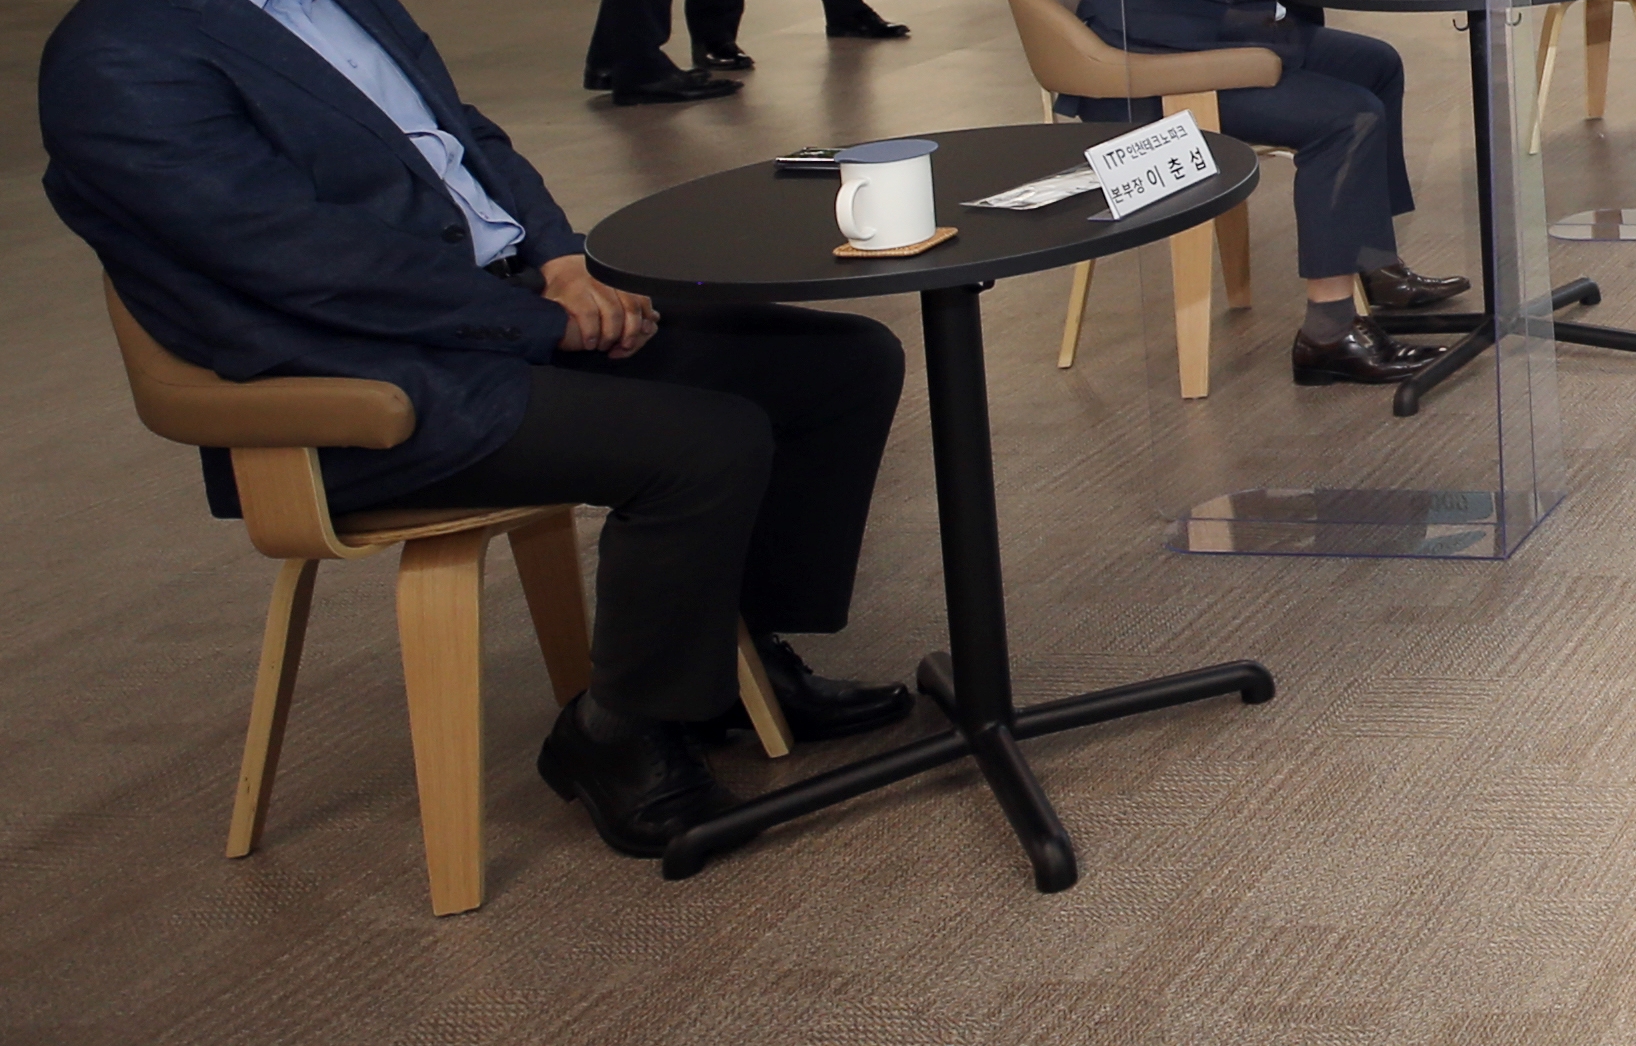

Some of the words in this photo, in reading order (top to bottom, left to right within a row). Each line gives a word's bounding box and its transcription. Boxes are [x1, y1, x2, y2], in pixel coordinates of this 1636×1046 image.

[1102, 148, 1127, 171] ITP
[1126, 125, 1188, 160] 인천테크노파크
[1110, 177, 1145, 204] 본부장
